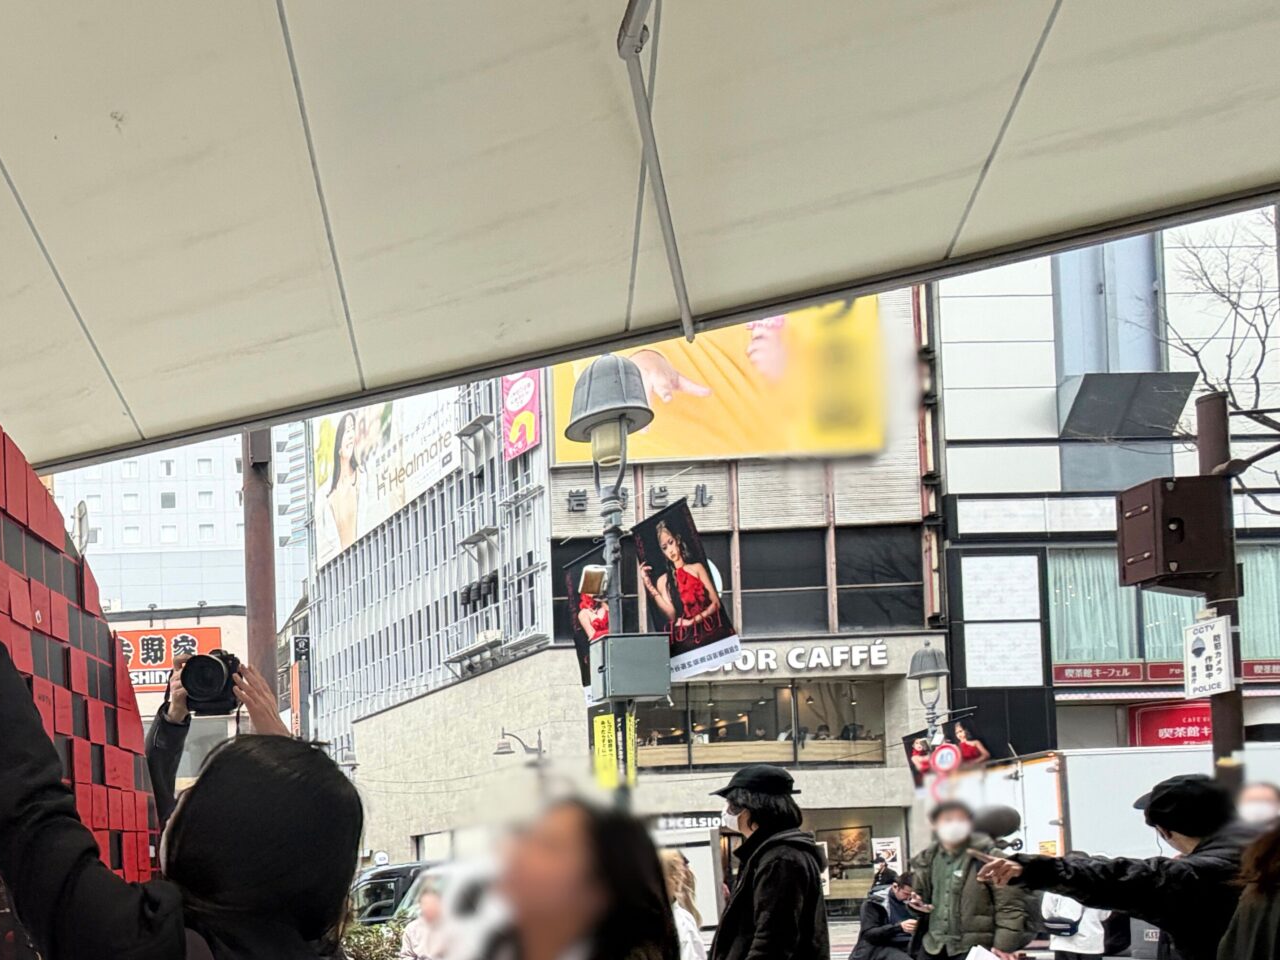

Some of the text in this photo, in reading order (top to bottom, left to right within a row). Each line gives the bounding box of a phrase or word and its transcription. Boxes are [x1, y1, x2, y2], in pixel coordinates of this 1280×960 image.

[389, 429, 452, 492] Healmate
[1193, 625, 1215, 635] CCTV
[787, 639, 889, 669] CAFFÉ
[1193, 682, 1222, 693] POLICE
